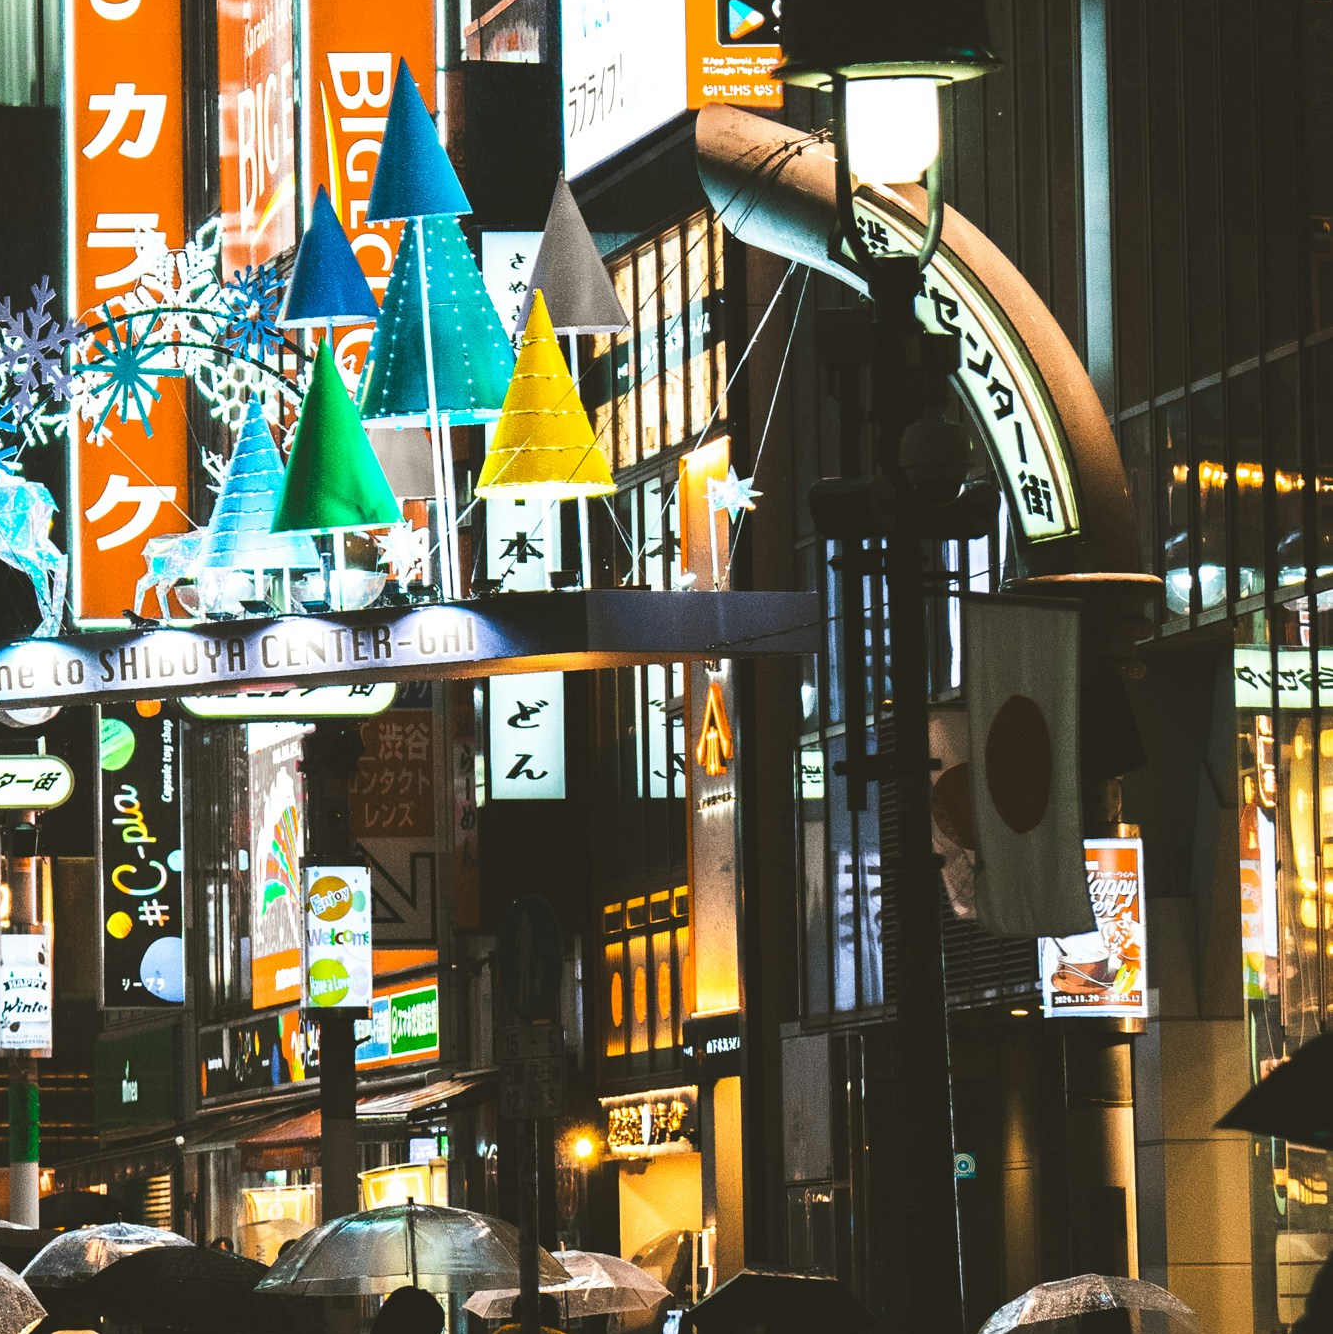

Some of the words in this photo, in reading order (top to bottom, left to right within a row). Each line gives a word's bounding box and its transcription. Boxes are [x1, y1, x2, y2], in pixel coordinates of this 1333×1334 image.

[83, 83, 178, 552] カラケ
[51, 655, 85, 687] to
[97, 636, 248, 684] SHIBUYA
[259, 617, 476, 671] CENTER-GAI
[162, 719, 174, 744] shop
[309, 885, 351, 915] Enjoy
